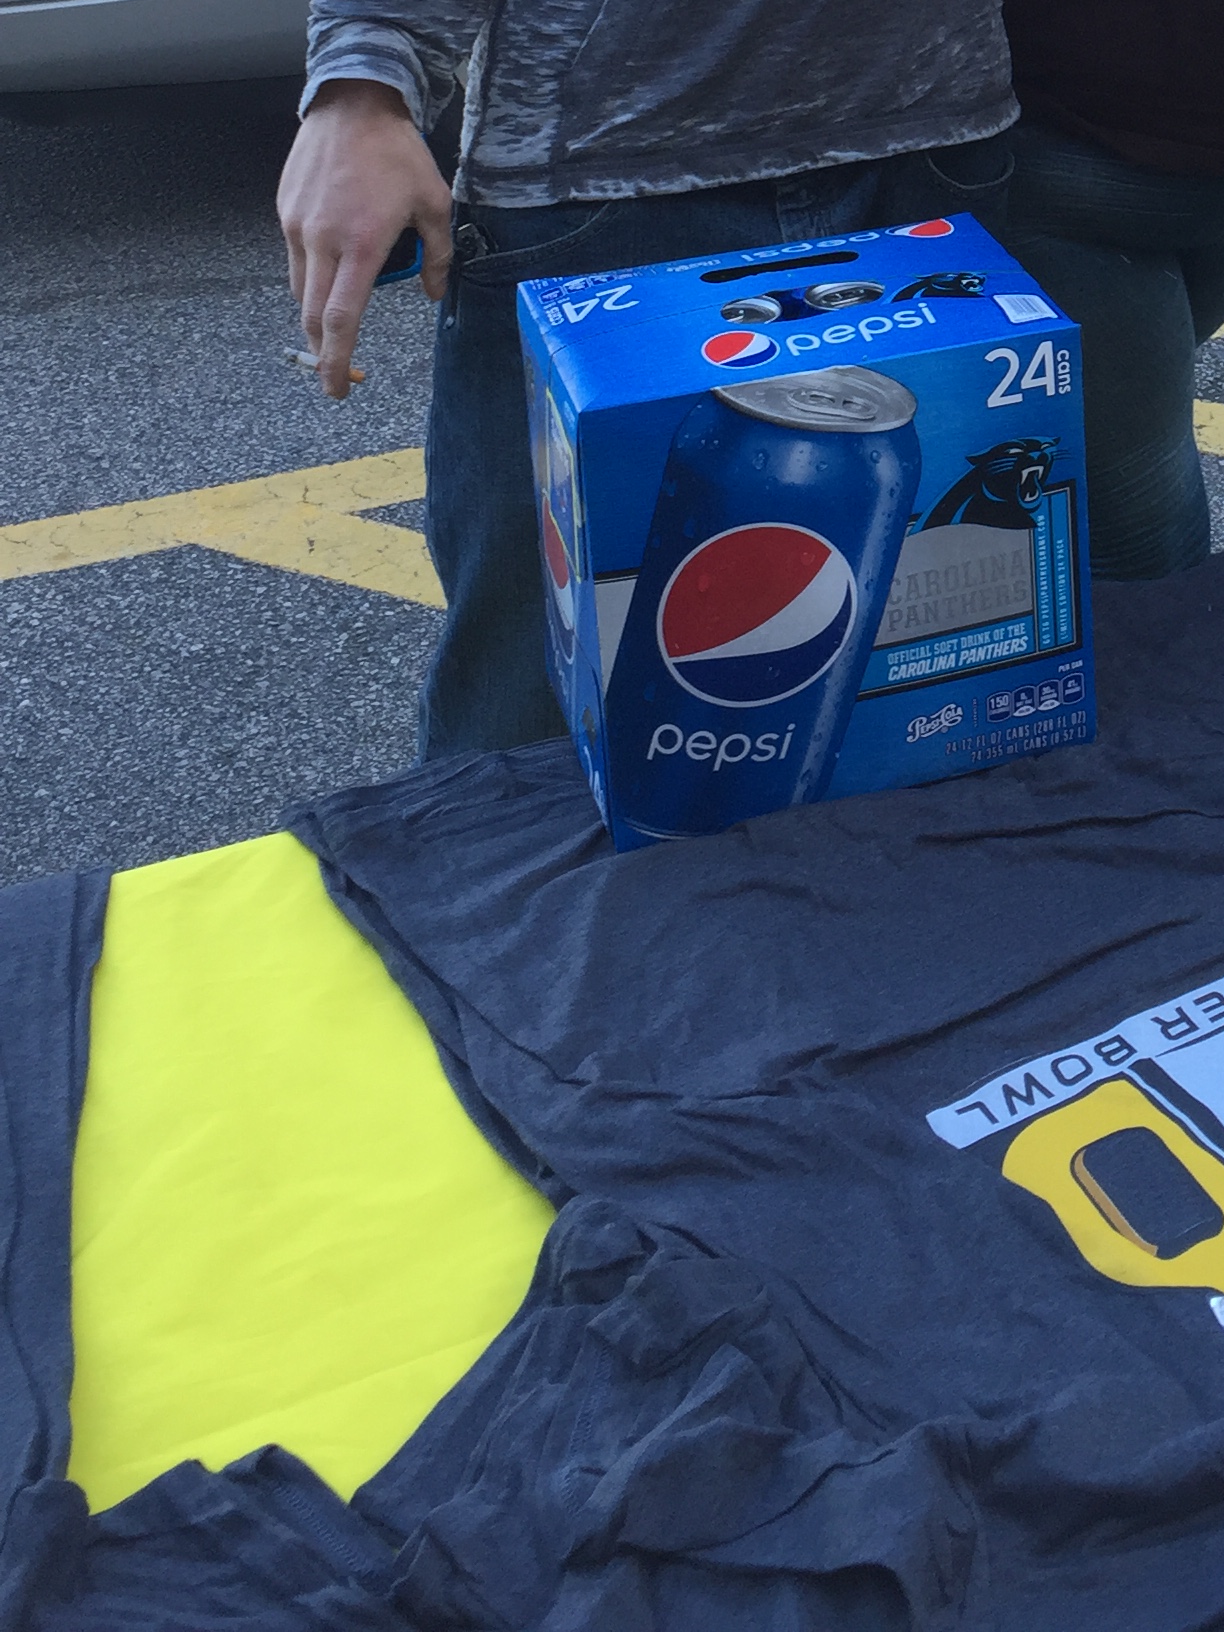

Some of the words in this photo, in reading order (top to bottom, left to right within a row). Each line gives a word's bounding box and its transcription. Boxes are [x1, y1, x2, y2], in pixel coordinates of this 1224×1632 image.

[741, 231, 880, 262] pepsi
[562, 284, 640, 324] 24
[786, 303, 937, 356] pepsi
[984, 340, 1055, 408] 24
[1056, 349, 1071, 395] cans
[887, 548, 1027, 606] CAROLINA
[887, 579, 1028, 632] PANTHERS
[887, 646, 932, 665] OFFICIAL
[934, 638, 958, 655] SOFT
[960, 631, 990, 648] DRINK
[992, 627, 1006, 641] OF
[1007, 623, 1026, 636] THE
[887, 654, 956, 682] CAROLINA
[958, 635, 1029, 667] PANTHERS
[990, 694, 1009, 709] 150
[646, 723, 796, 772] pepsi
[1006, 724, 1030, 741] CANS
[1057, 715, 1067, 728] FL
[1024, 735, 1047, 751] CANS
[956, 1034, 1137, 1125] BOWL
